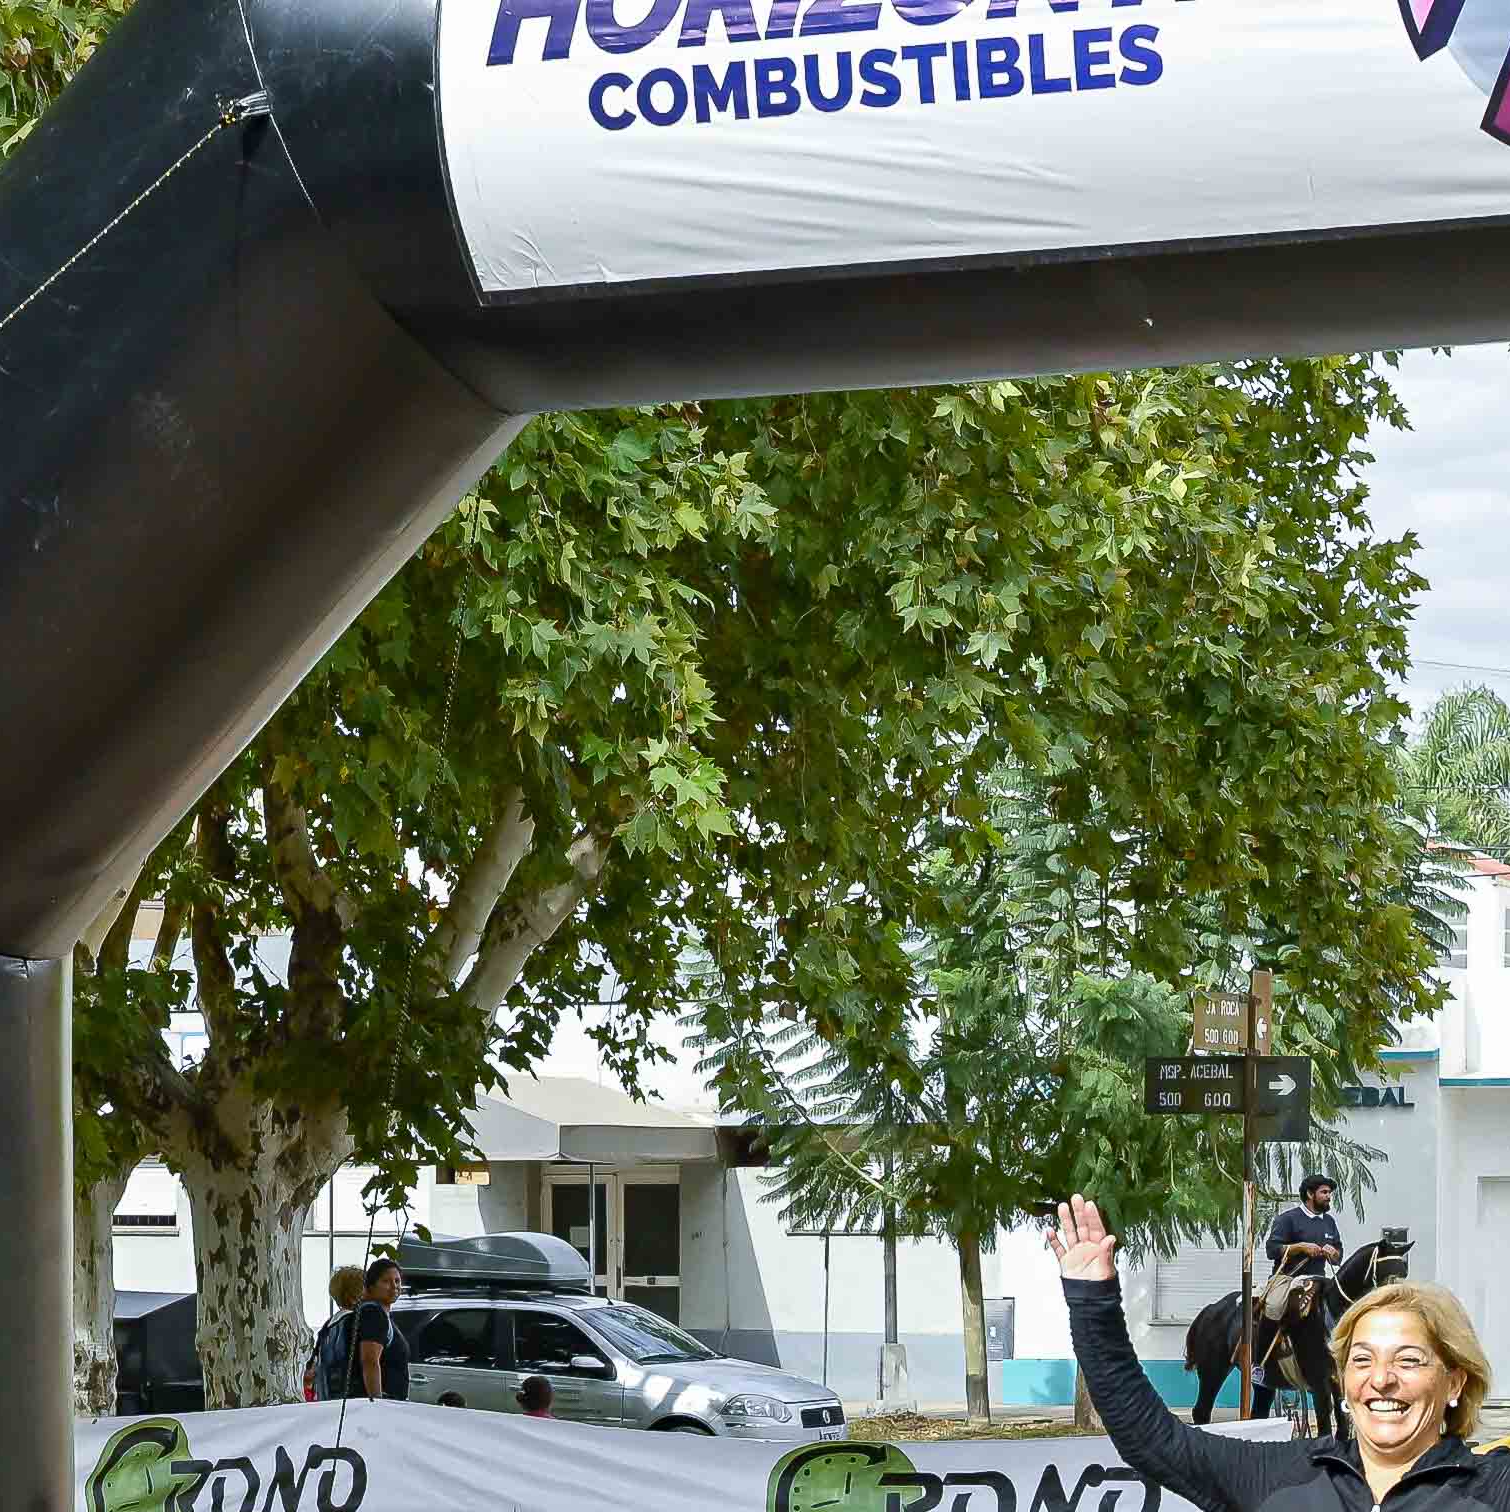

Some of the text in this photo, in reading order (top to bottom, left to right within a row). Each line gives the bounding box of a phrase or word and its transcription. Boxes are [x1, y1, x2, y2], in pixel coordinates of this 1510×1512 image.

[589, 24, 1163, 131] COMBUSTIBLES
[1204, 1028, 1239, 1045] 500 600
[1190, 1063, 1234, 1078] ACEBAL
[1159, 1092, 1231, 1107] 500 600
